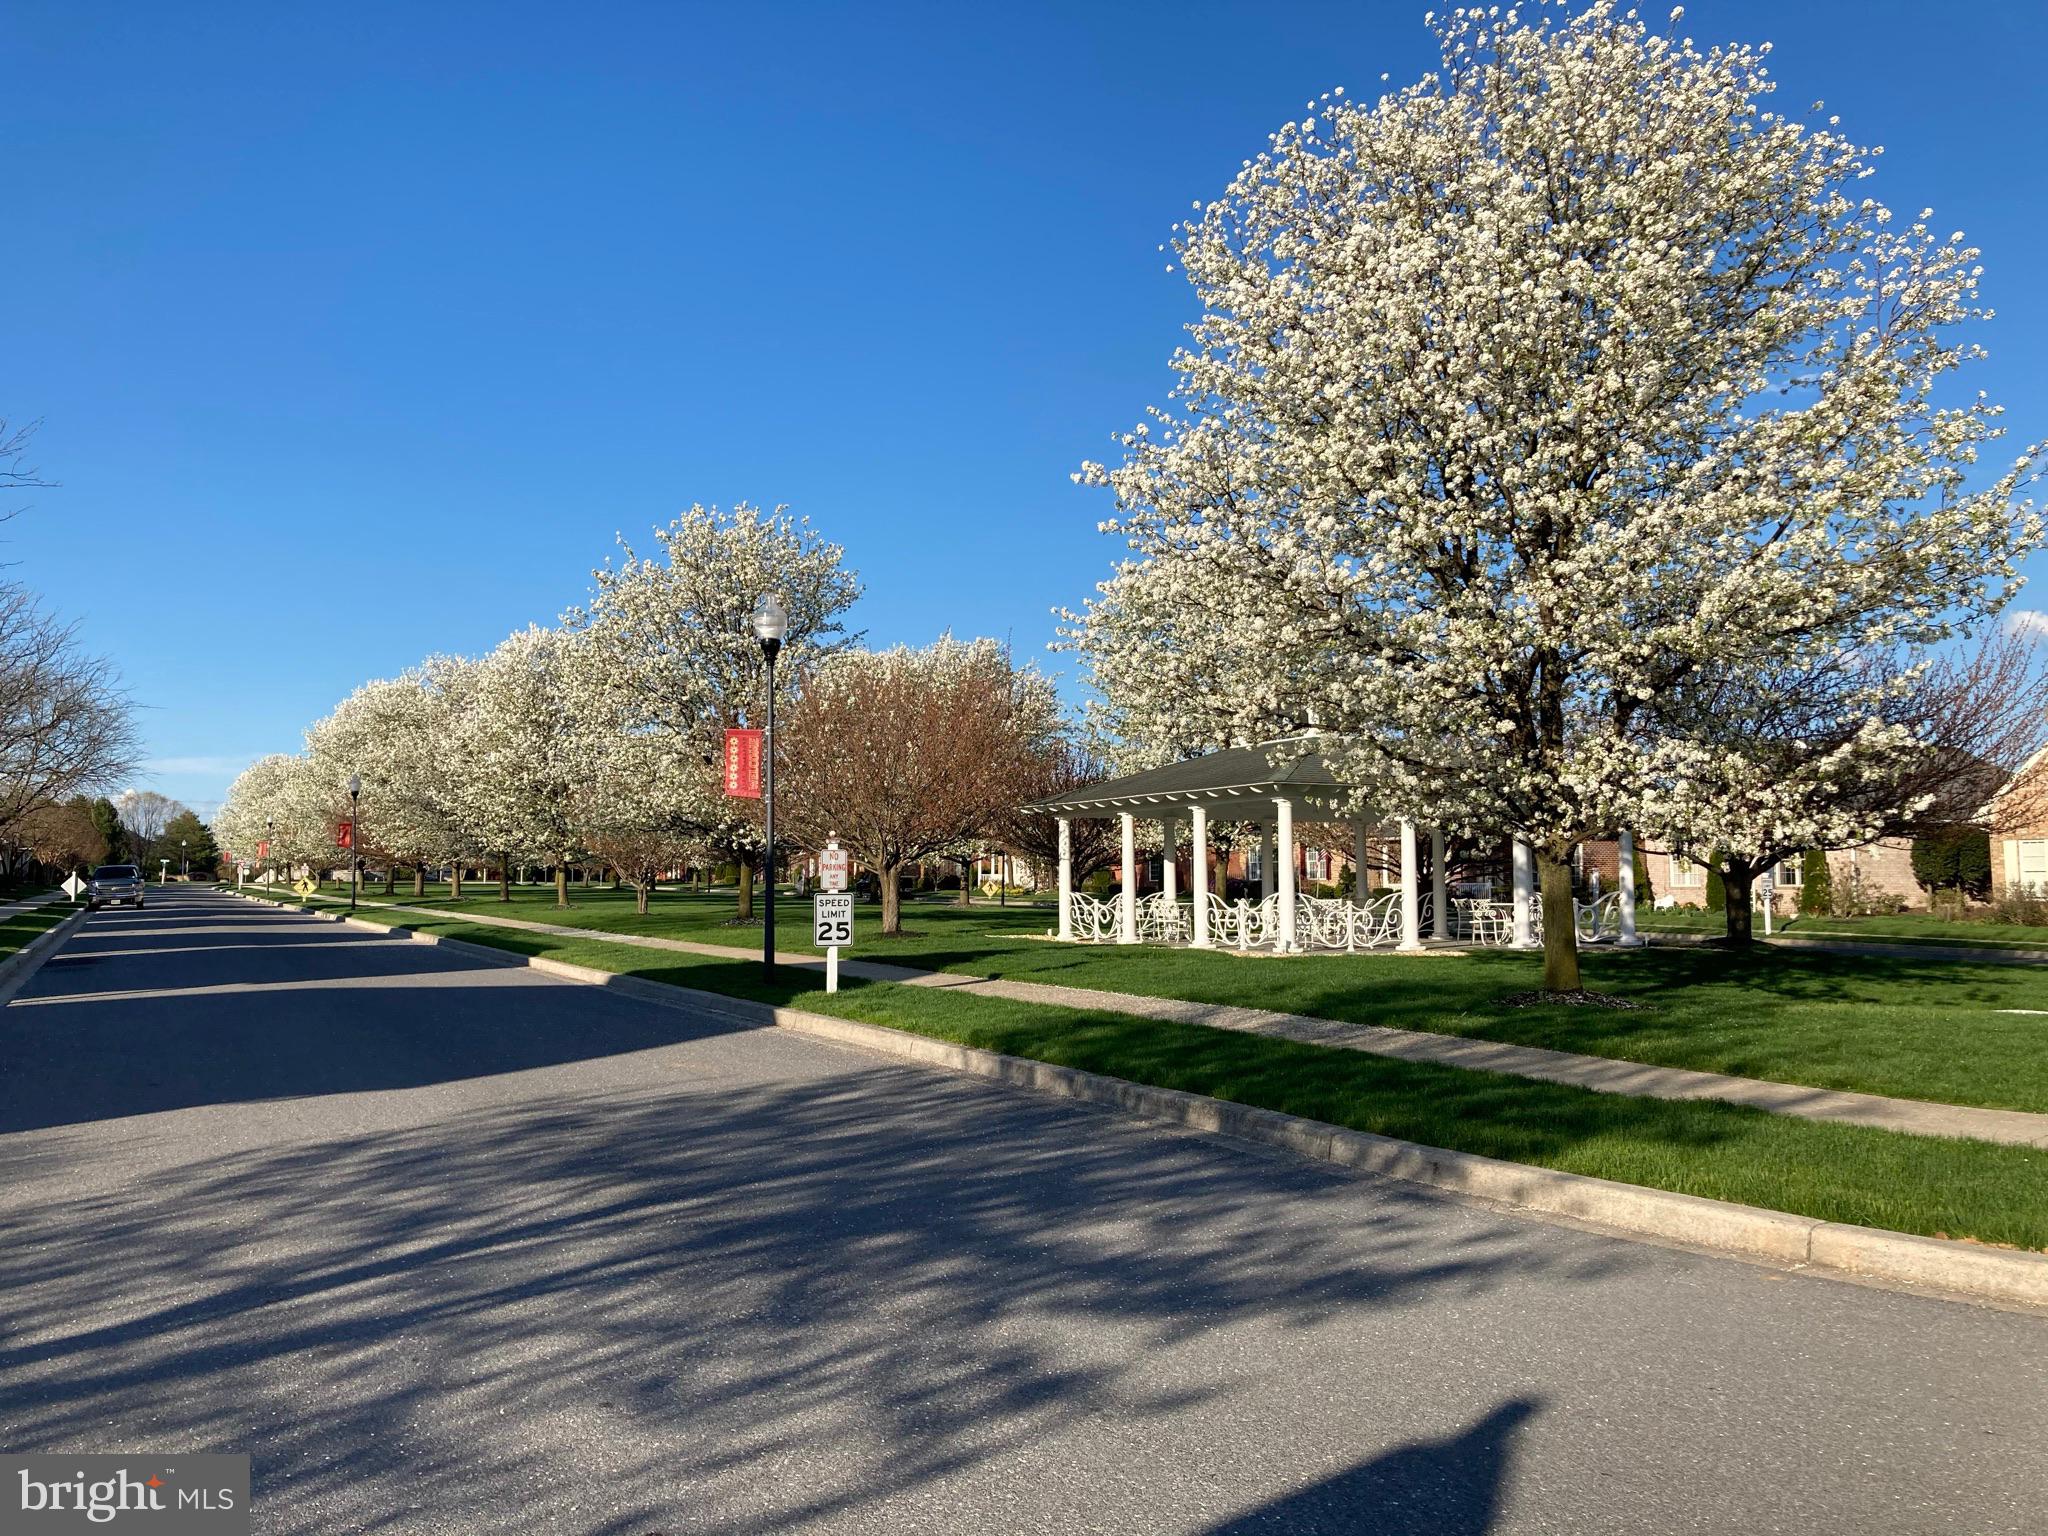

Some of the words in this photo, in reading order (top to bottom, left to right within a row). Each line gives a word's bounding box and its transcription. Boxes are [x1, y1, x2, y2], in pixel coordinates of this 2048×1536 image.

[829, 852, 839, 861] NO
[822, 863, 847, 872] PARKING
[1762, 888, 1772, 896] 25
[818, 899, 850, 907] SPEED
[821, 910, 847, 918] LIMIT
[818, 921, 850, 941] 25
